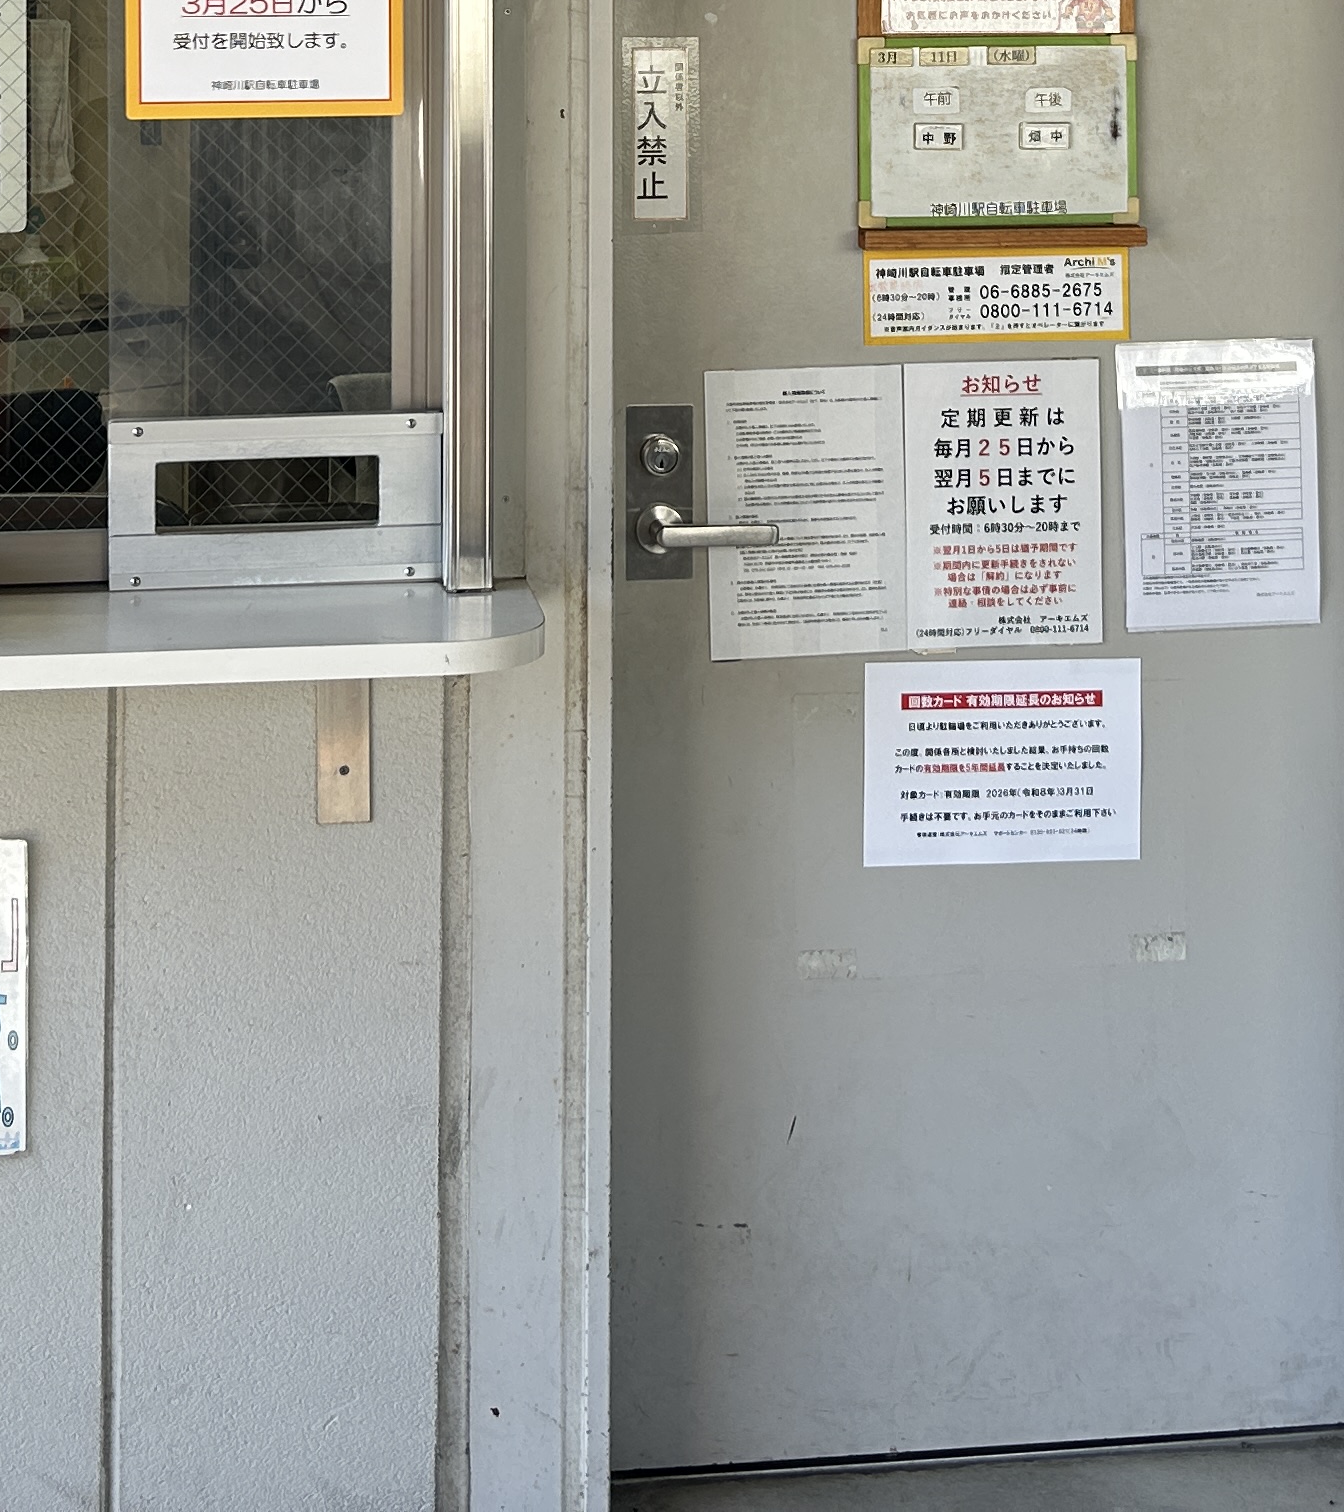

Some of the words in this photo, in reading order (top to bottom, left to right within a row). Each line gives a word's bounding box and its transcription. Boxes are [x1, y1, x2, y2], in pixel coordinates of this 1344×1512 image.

[172, 31, 349, 51] 受付を開始致します。
[877, 51, 897, 64] 3月
[923, 92, 952, 106] 午前
[1035, 92, 1063, 107] 午後
[636, 64, 669, 200] 立入禁止
[922, 131, 957, 145] 中野
[1000, 263, 1054, 276] 指定管理者
[1063, 257, 1095, 267] Archi
[979, 282, 1102, 300] 06-6885-2675
[980, 301, 1113, 319] 0800-111-6714
[961, 374, 1042, 394] お知らせ
[940, 406, 1065, 429] 定期更新は
[934, 437, 1075, 459] 毎月25日から
[934, 466, 1076, 489] 翌月5日までに
[946, 494, 1069, 516] お願いします
[947, 570, 1063, 583] 場合は「解約」になります
[1039, 614, 1089, 623] アーキエムズ
[908, 694, 962, 708] 回数カード
[966, 692, 1096, 708] 有効期限延長のお知らせ
